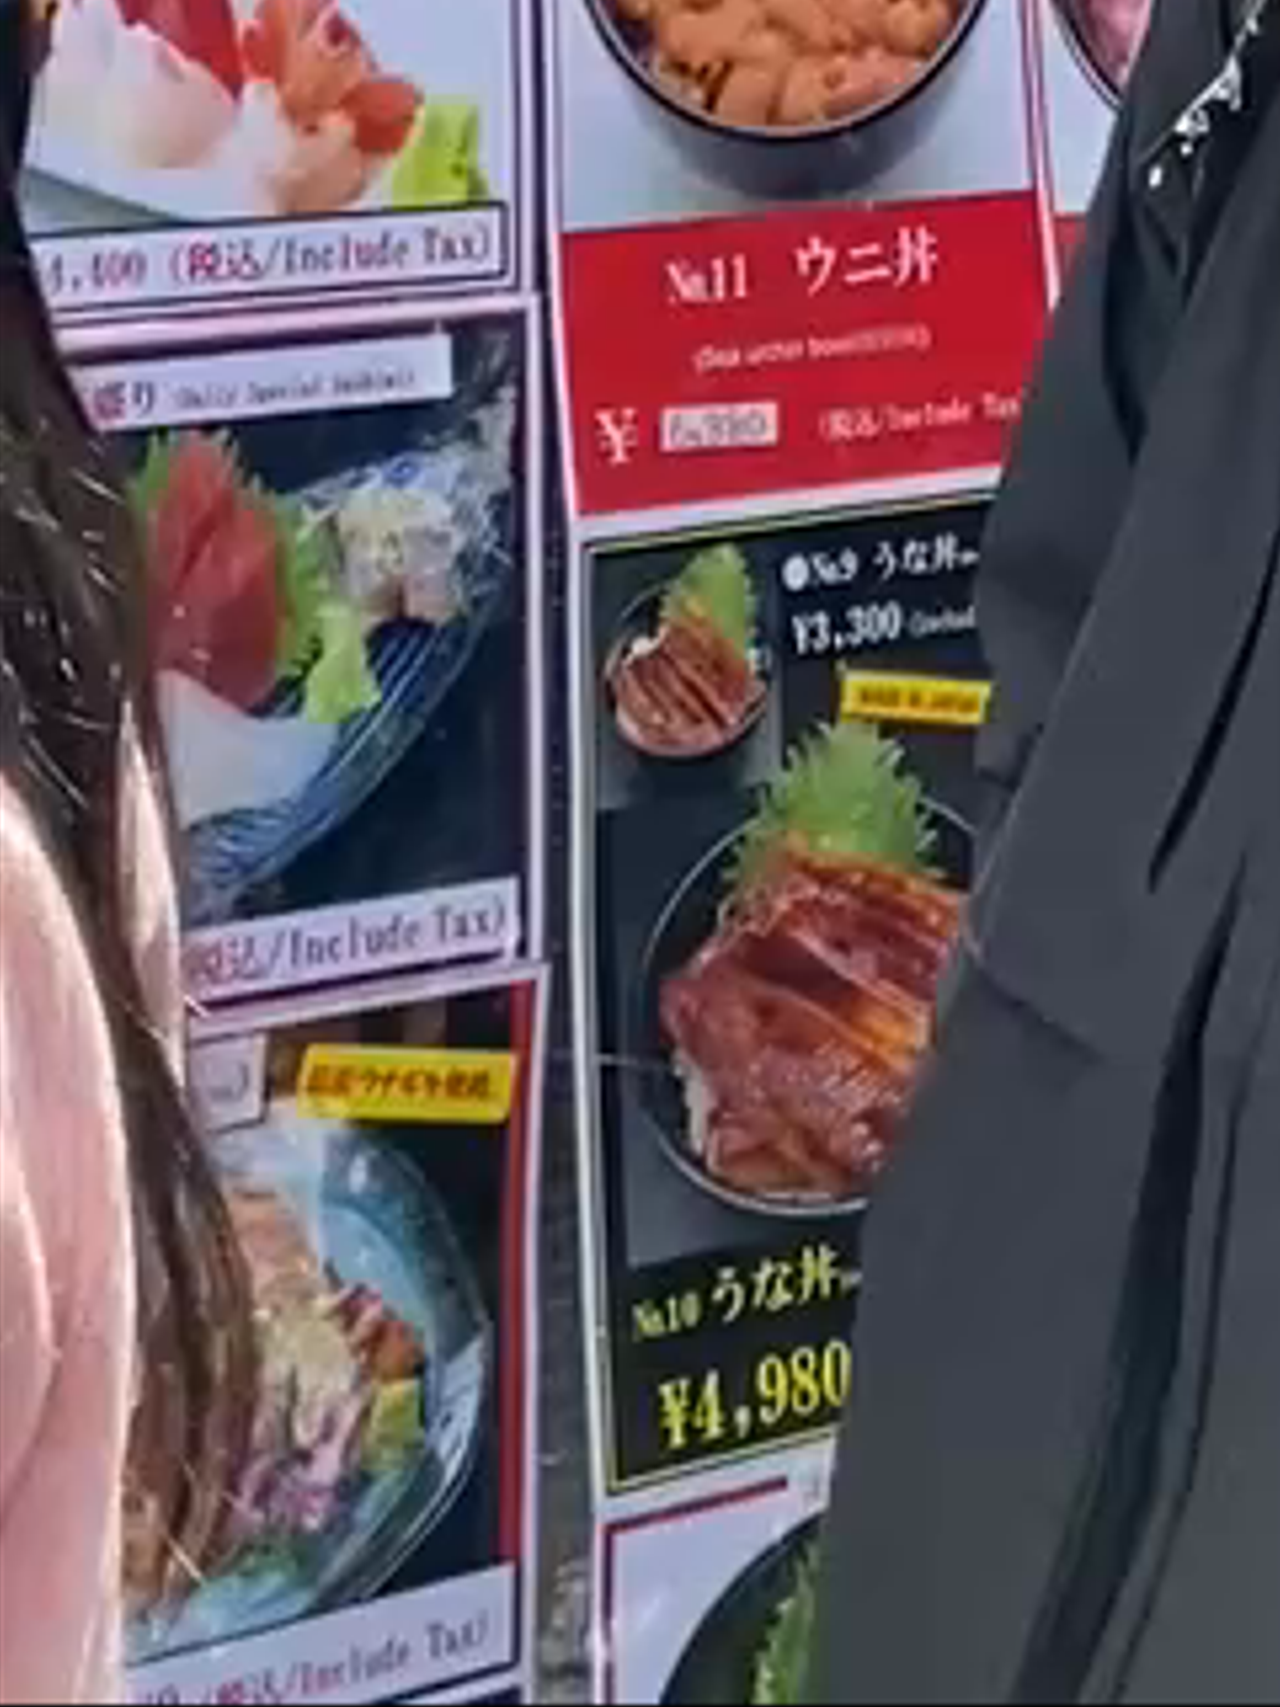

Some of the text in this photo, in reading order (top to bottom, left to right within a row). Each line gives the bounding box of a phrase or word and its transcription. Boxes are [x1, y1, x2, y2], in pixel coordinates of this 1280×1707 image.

[794, 223, 939, 297] ウニ丼
[657, 1338, 852, 1449] ¥4,980
